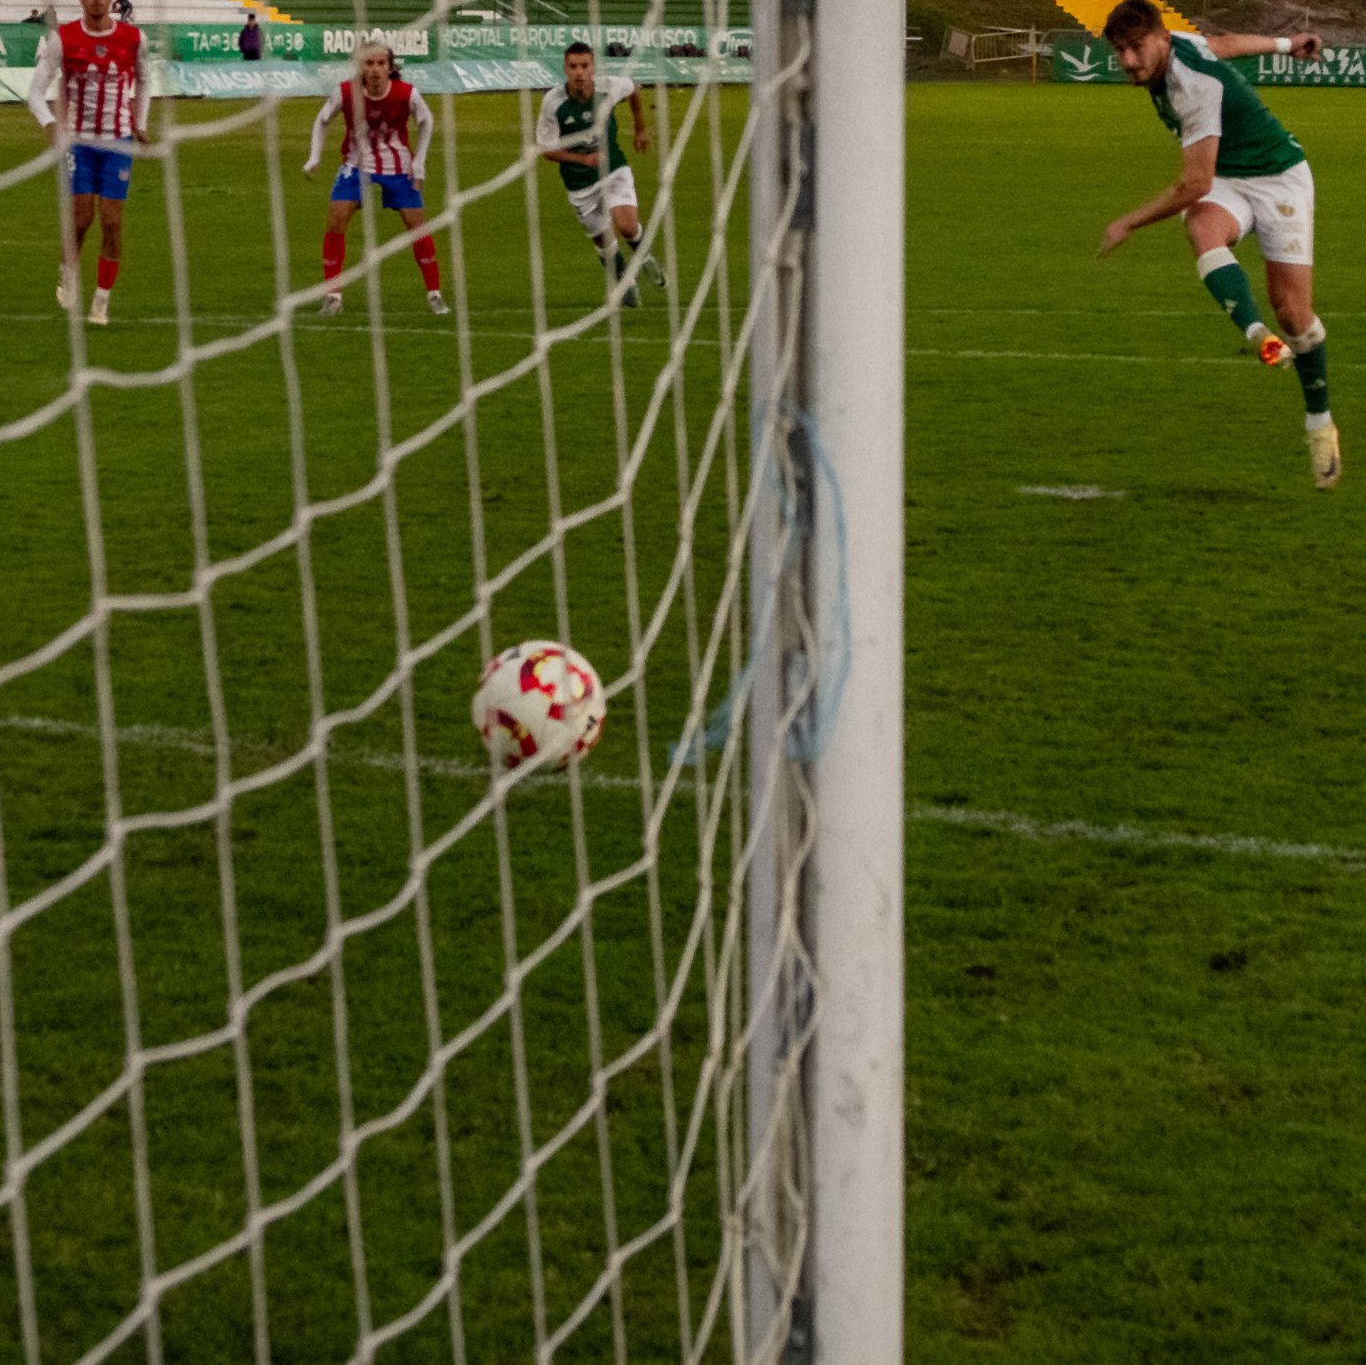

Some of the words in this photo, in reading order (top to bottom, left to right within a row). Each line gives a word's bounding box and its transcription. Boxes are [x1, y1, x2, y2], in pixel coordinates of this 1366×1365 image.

[510, 27, 566, 50] PARQUE
[572, 27, 602, 47] SAN
[606, 27, 697, 48] FRANCISCO
